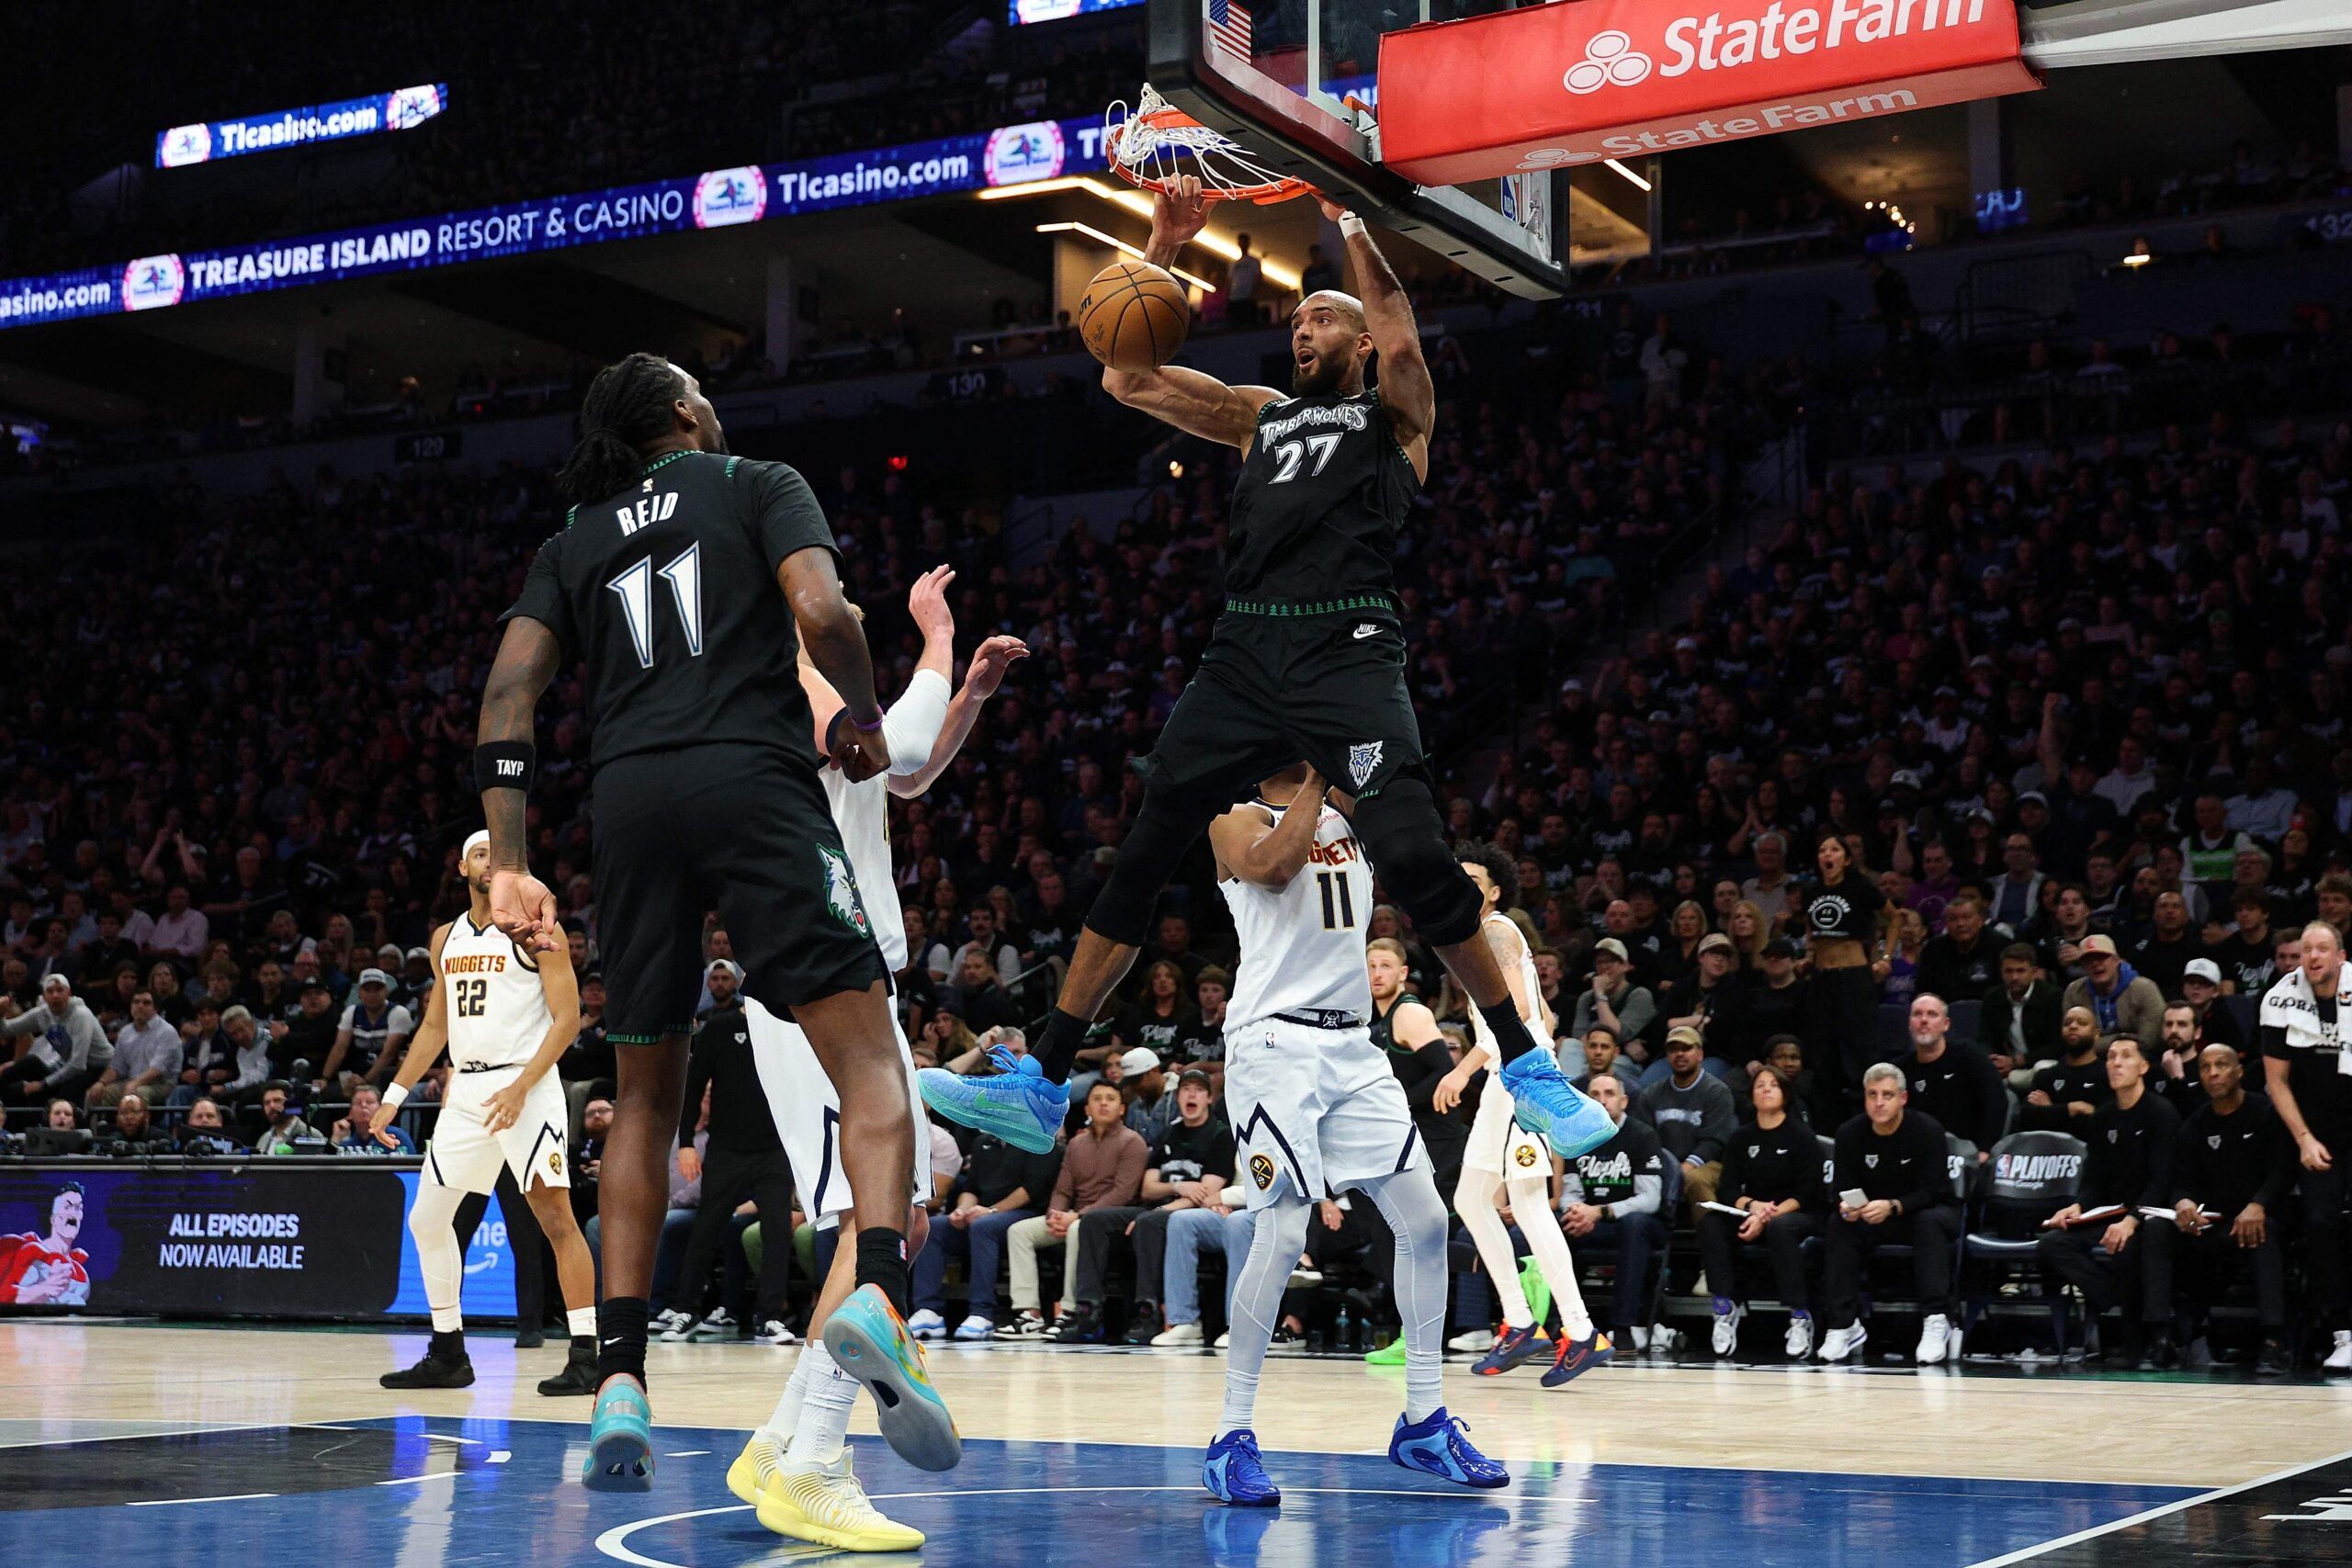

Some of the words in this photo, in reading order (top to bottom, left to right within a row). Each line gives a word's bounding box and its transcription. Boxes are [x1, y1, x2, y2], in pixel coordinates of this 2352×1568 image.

[1658, 0, 1821, 78] State
[1825, 0, 1984, 50] Farm
[1601, 118, 1759, 155] State
[1760, 89, 1918, 130] Farm
[189, 243, 325, 289] TREASURE
[331, 229, 431, 269] ISLAND
[437, 210, 540, 254] RESORT
[546, 207, 566, 238] &
[574, 190, 684, 234] CASINO
[777, 155, 968, 203] TIcasino.com
[1260, 403, 1373, 453] TIMBERWOLVES
[1268, 432, 1343, 485] 27
[616, 491, 679, 537] REID
[605, 539, 704, 670] 11
[1358, 624, 1377, 634] NIKE
[496, 759, 525, 777] TAYP
[1317, 871, 1355, 931] 11
[445, 955, 506, 976] NUGGETS
[457, 979, 487, 1017] 22
[2009, 1155, 2082, 1180] PLAYOFFS
[169, 1213, 206, 1236] ALL
[208, 1213, 300, 1238] EPISODES
[159, 1244, 205, 1269] NOW
[204, 1244, 305, 1269] AVAILABLE
